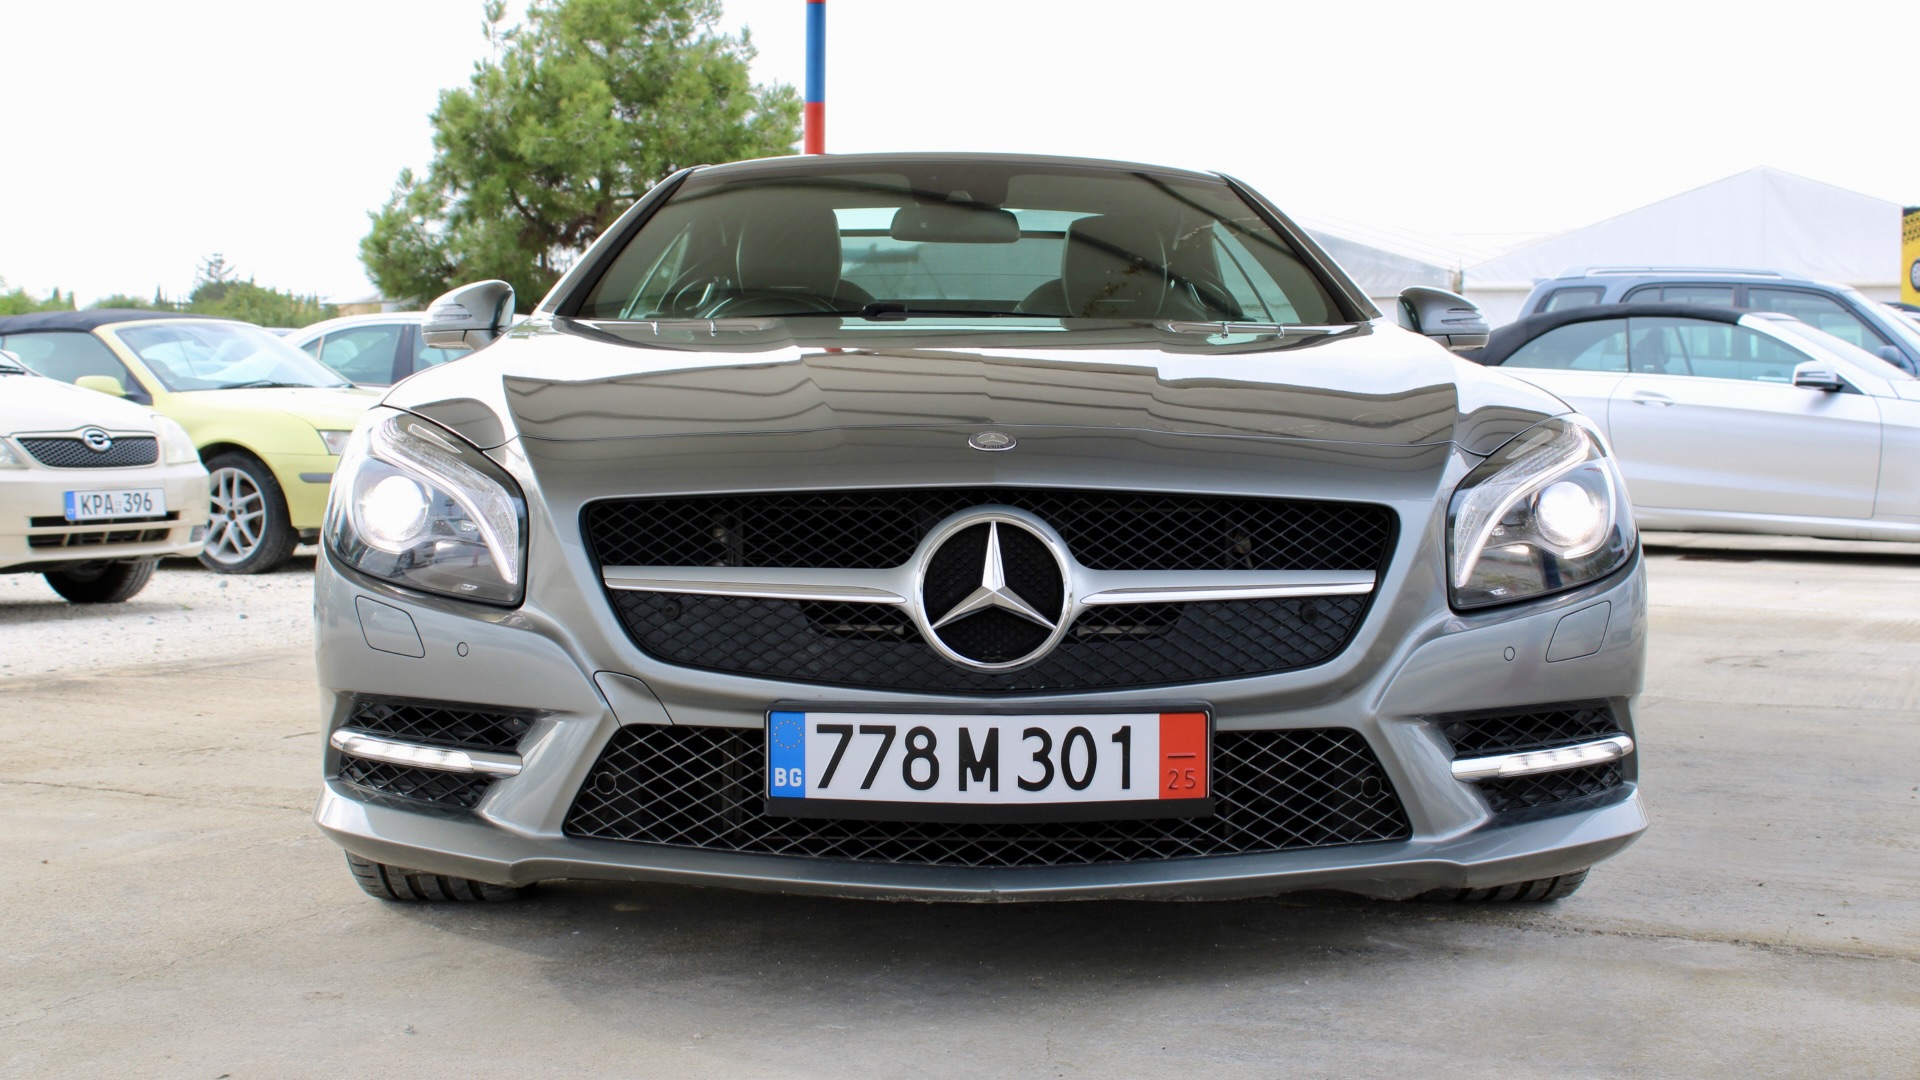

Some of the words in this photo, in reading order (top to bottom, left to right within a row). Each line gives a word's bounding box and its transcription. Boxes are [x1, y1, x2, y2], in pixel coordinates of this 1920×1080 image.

[80, 494, 114, 515] KPA
[123, 492, 152, 513] 396
[816, 724, 940, 791] 778
[958, 727, 999, 792] M
[1017, 725, 1131, 791] 301
[774, 767, 802, 787] BG
[1168, 768, 1196, 790] 25
